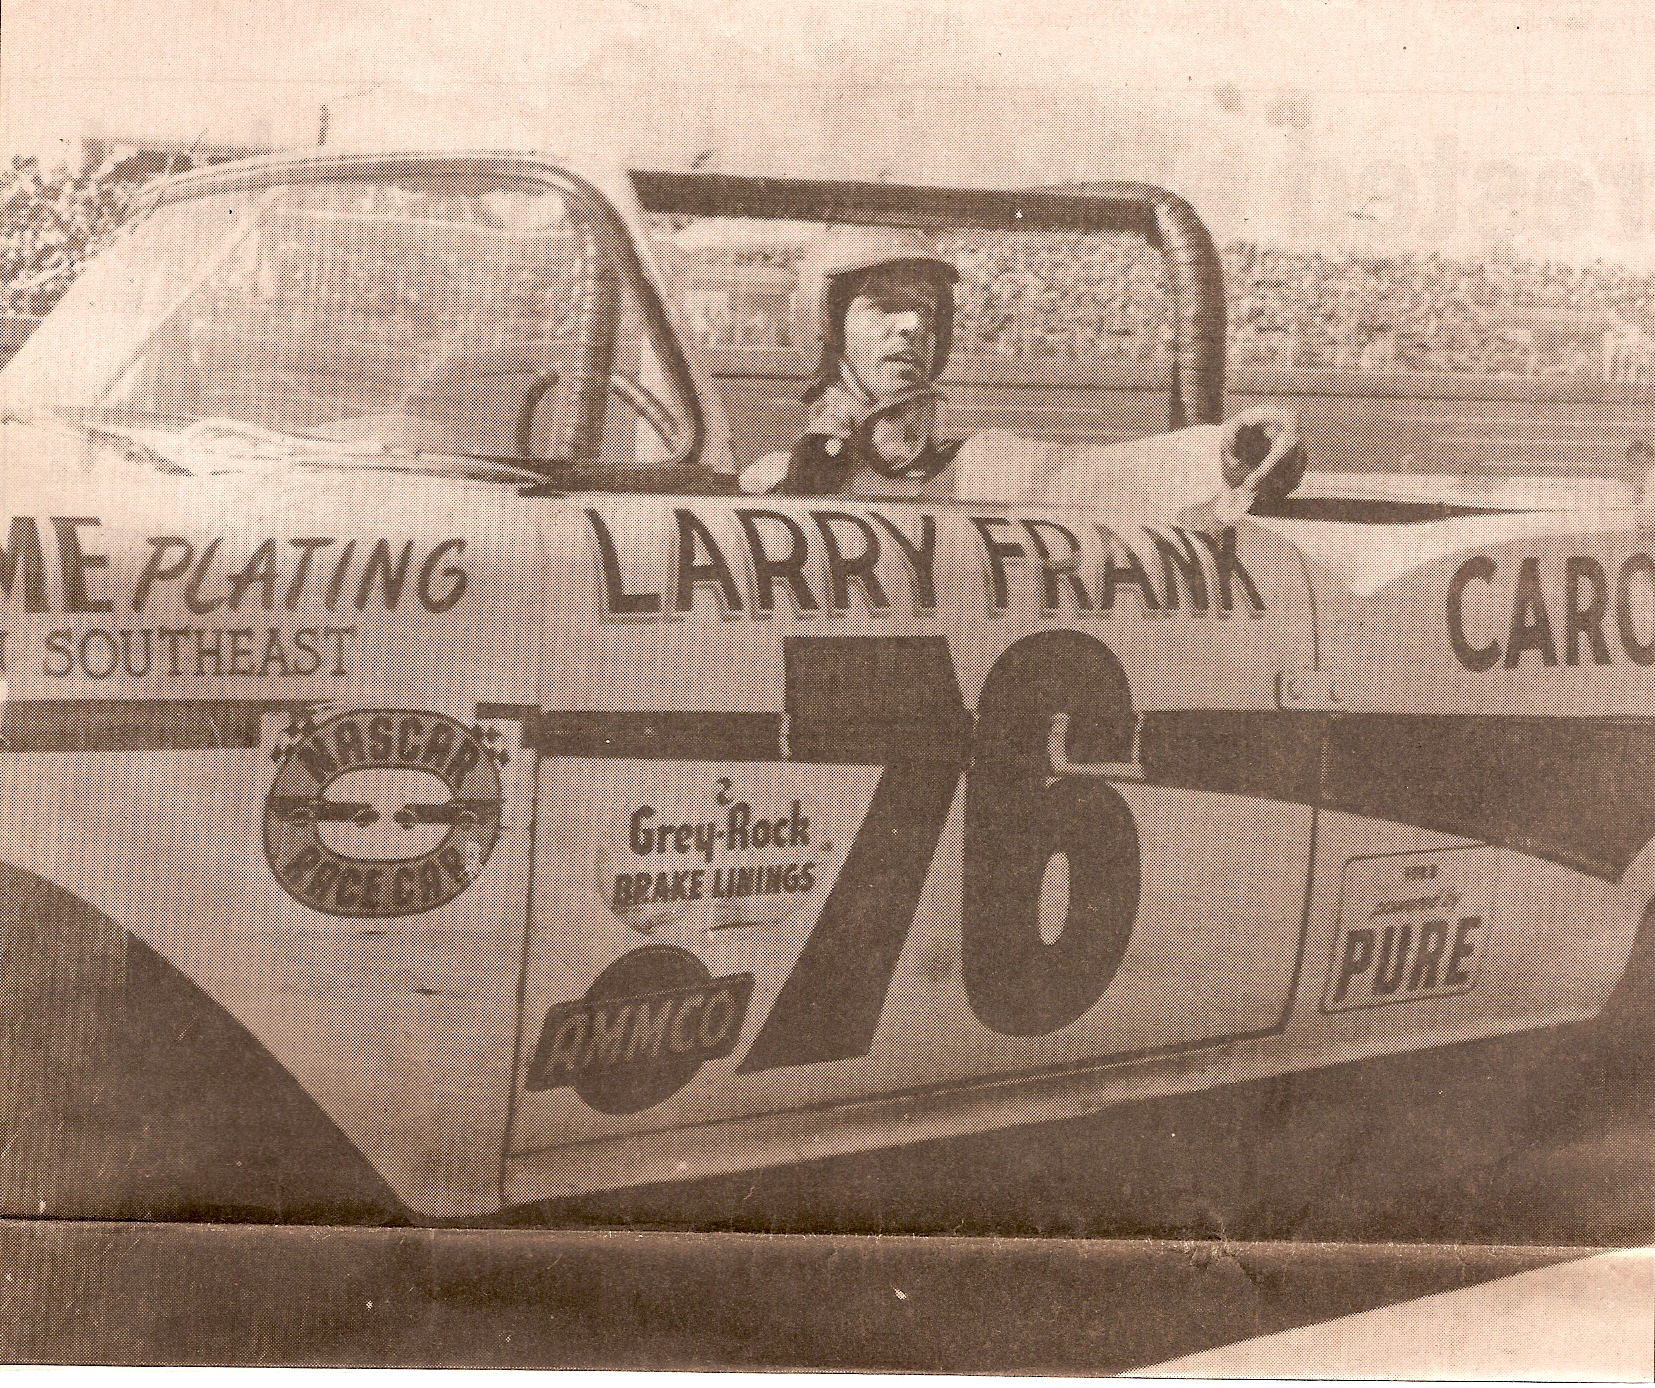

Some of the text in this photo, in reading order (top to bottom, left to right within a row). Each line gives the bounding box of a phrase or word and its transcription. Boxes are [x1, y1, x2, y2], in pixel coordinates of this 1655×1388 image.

[132, 536, 468, 614] PLATING
[586, 507, 1267, 616] LARRY FRANK
[44, 627, 357, 679] SOUTHEAST
[297, 715, 480, 789] NASCAR
[629, 799, 812, 863] Grey-Rock
[735, 629, 1142, 1074] 76
[283, 845, 383, 910] RACE
[393, 846, 470, 908] CAR
[613, 861, 817, 907] BRAKE LININGS
[1335, 916, 1482, 1002] PURE
[544, 989, 736, 1074] AMMCO
